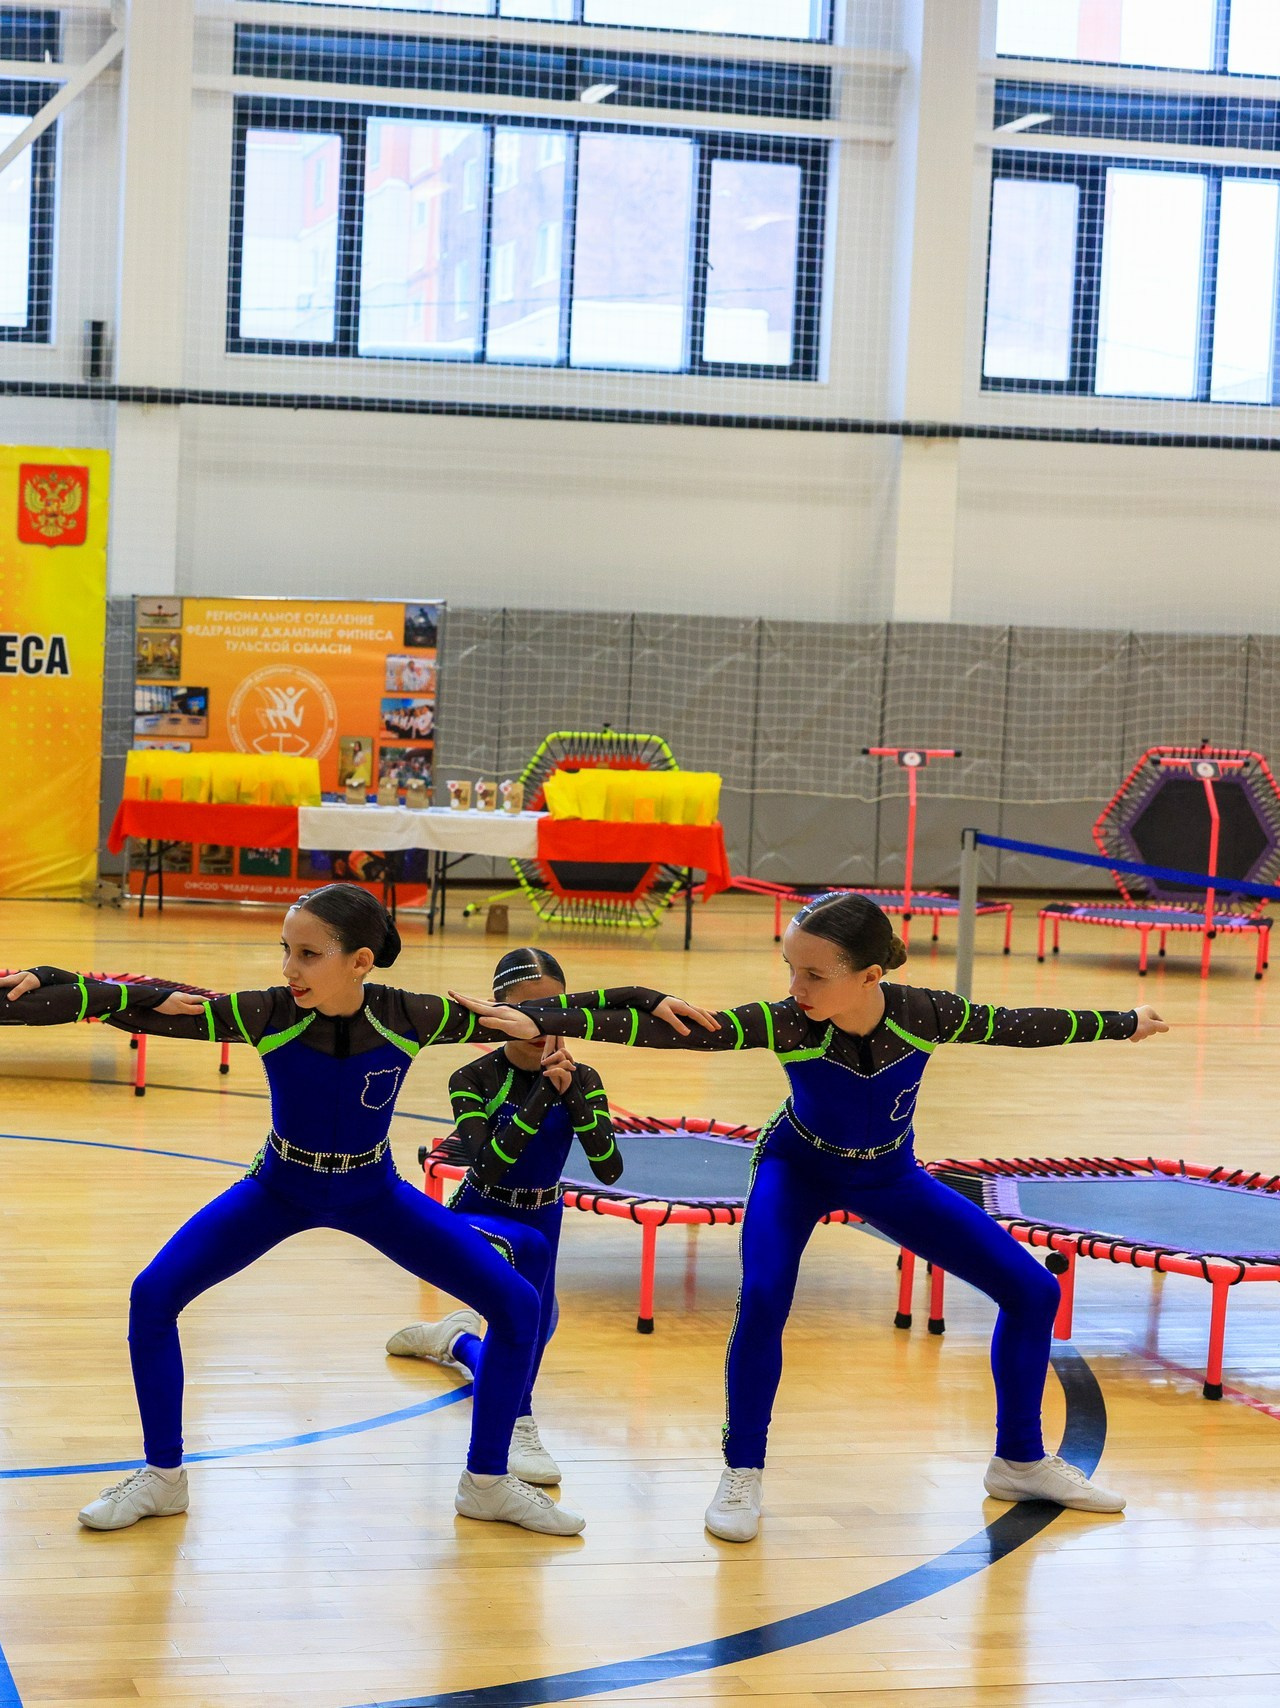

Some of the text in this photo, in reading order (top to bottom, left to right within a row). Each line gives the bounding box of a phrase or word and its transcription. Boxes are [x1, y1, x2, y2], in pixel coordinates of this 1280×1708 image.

[205, 610, 375, 625] РЕГИОНАЛЬНОЕ ОТДЕЛЕНИЕ
[261, 626, 333, 639] ДЖАМПИНГ
[336, 629, 394, 641] ФИТНЕСА
[226, 640, 353, 655] ТУЛЬСКОЙ ОБЛАСТИ
